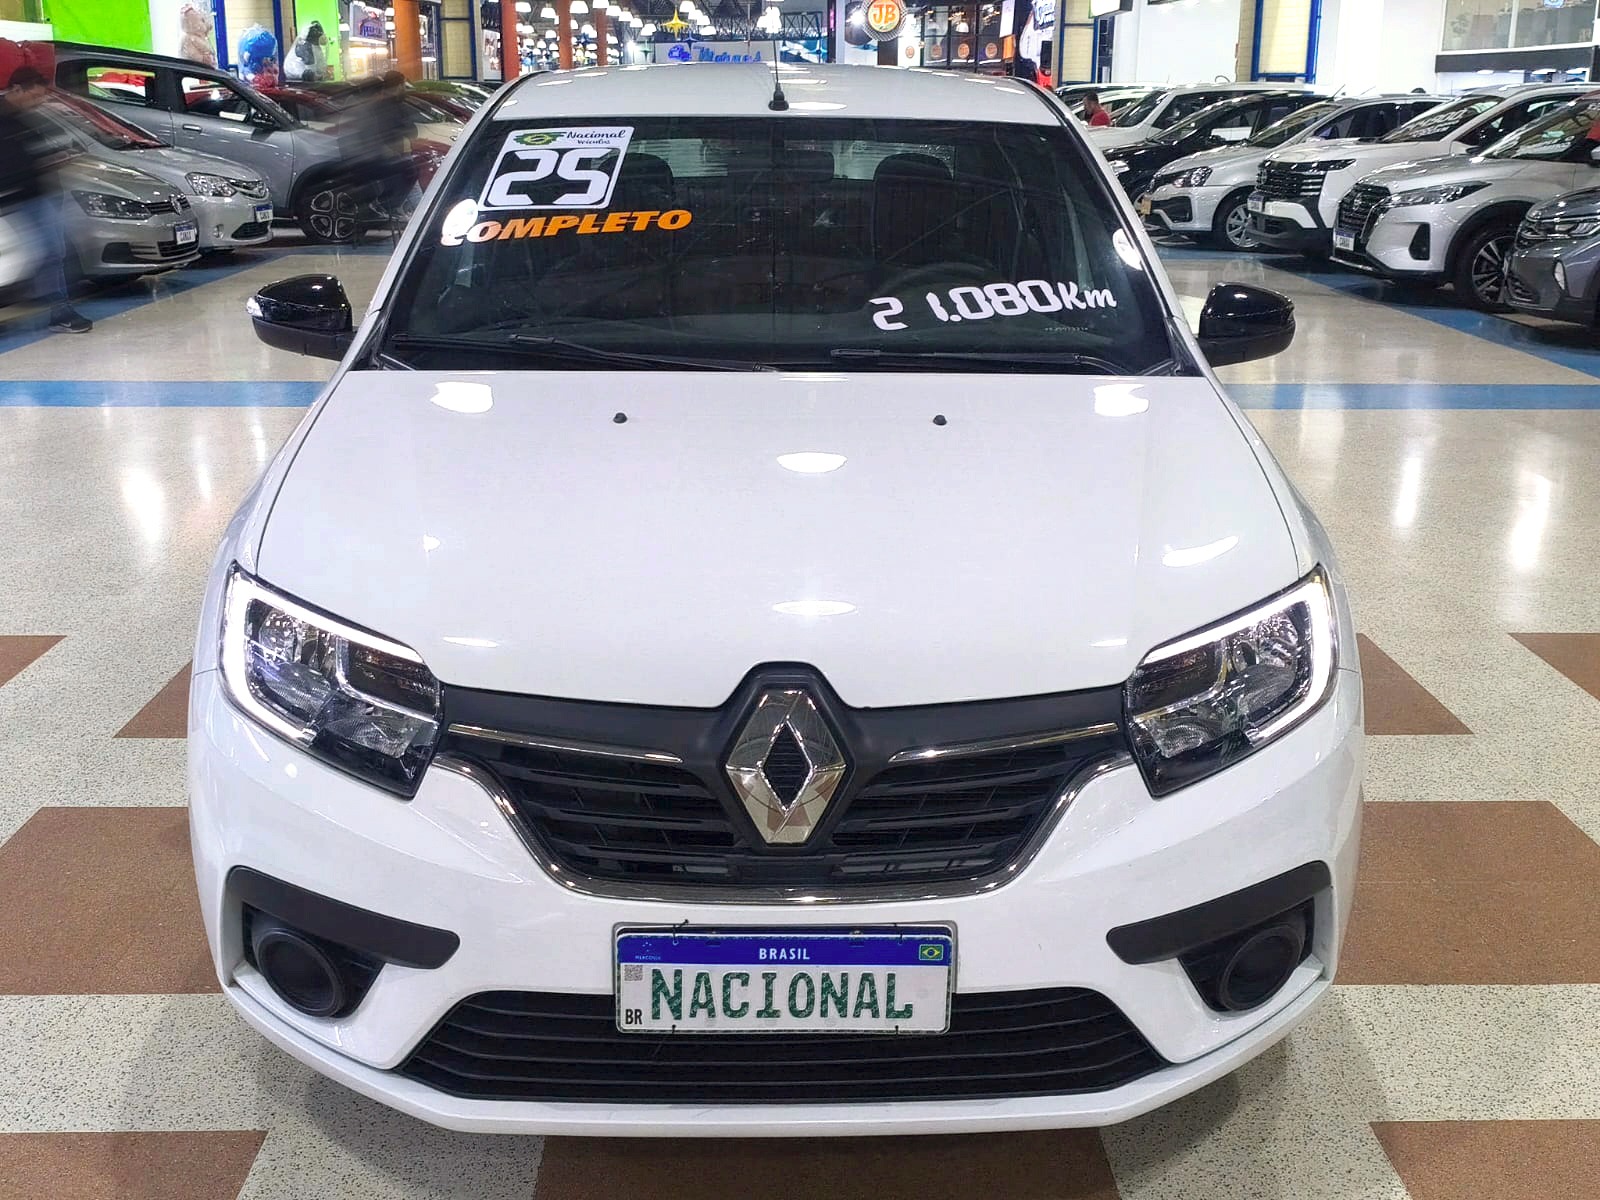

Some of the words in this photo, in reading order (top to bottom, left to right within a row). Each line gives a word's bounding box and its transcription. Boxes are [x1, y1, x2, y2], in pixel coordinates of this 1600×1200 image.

[873, 3, 897, 25] JB
[567, 129, 626, 139] Nacional
[487, 148, 613, 206] 25
[759, 947, 810, 960] BRASIL
[651, 968, 914, 1021] NACIONAL
[625, 1008, 643, 1025] BR
